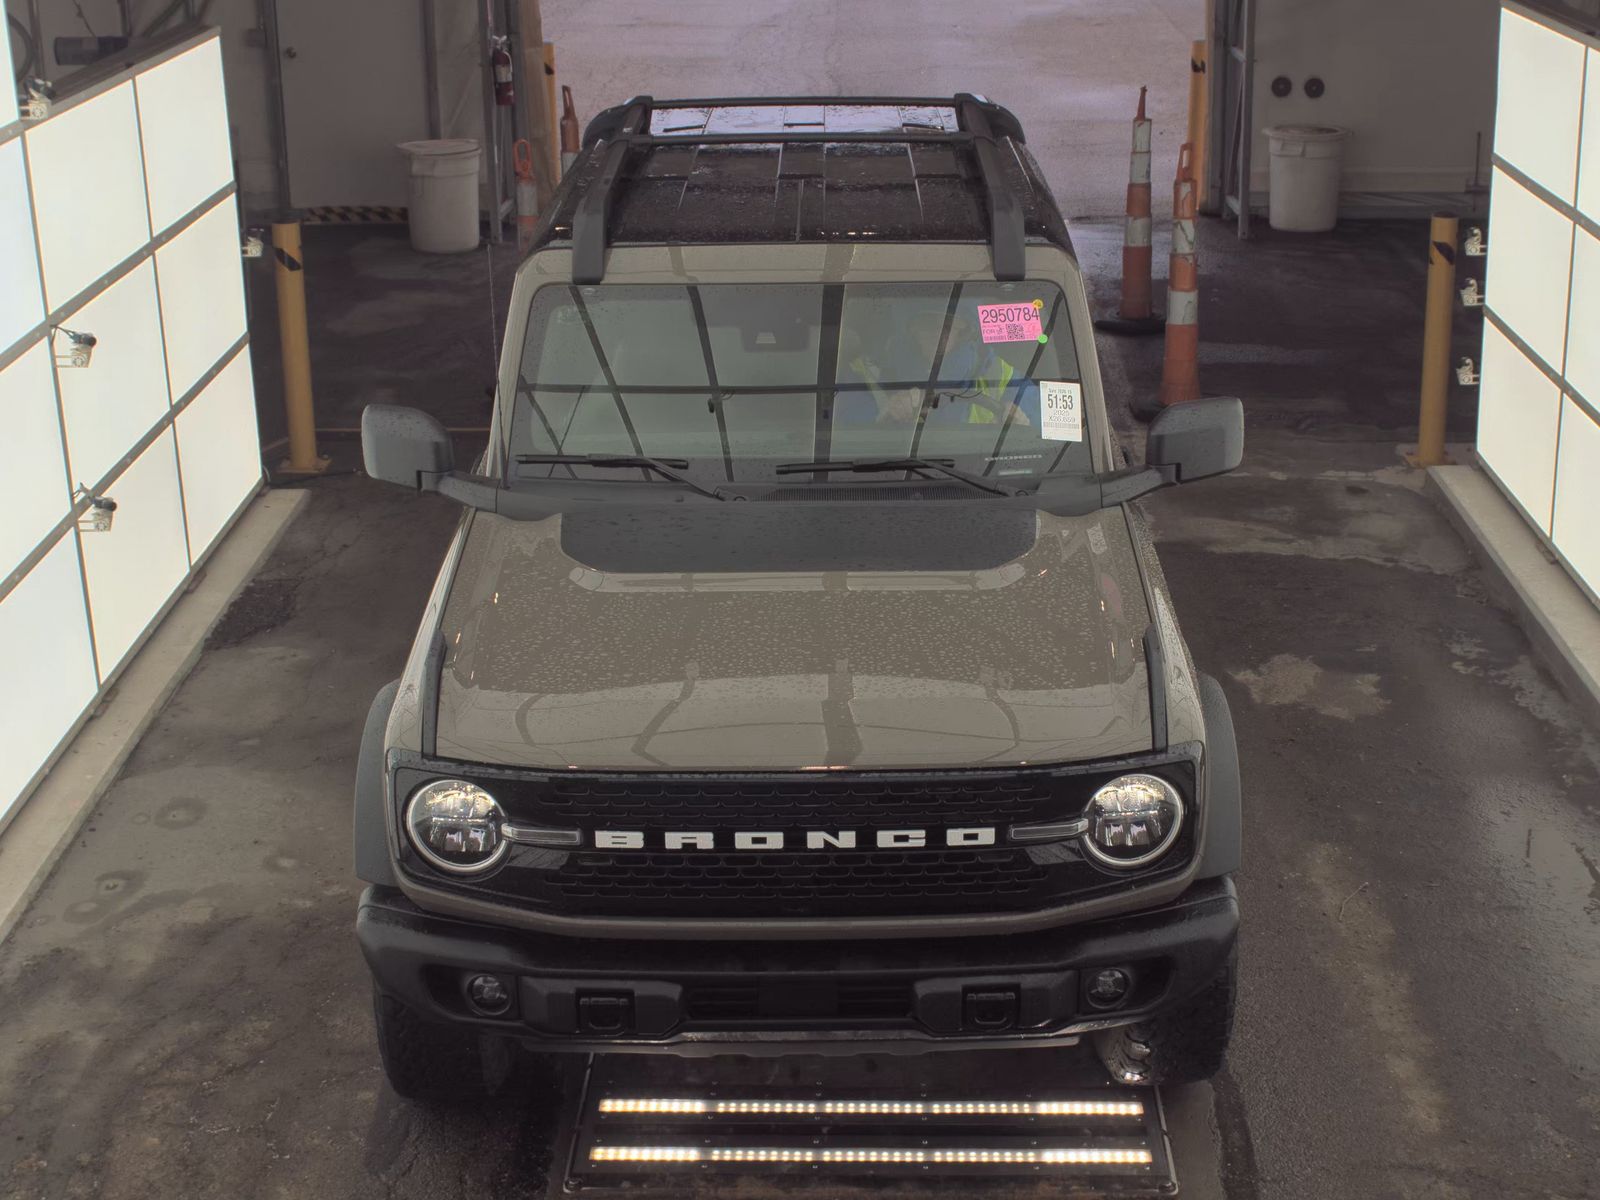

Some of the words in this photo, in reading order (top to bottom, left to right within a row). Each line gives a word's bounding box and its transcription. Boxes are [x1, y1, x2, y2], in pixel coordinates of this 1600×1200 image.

[981, 307, 1039, 323] 2950784
[1047, 394, 1073, 410] 51:53
[595, 827, 996, 850] BRONCO
